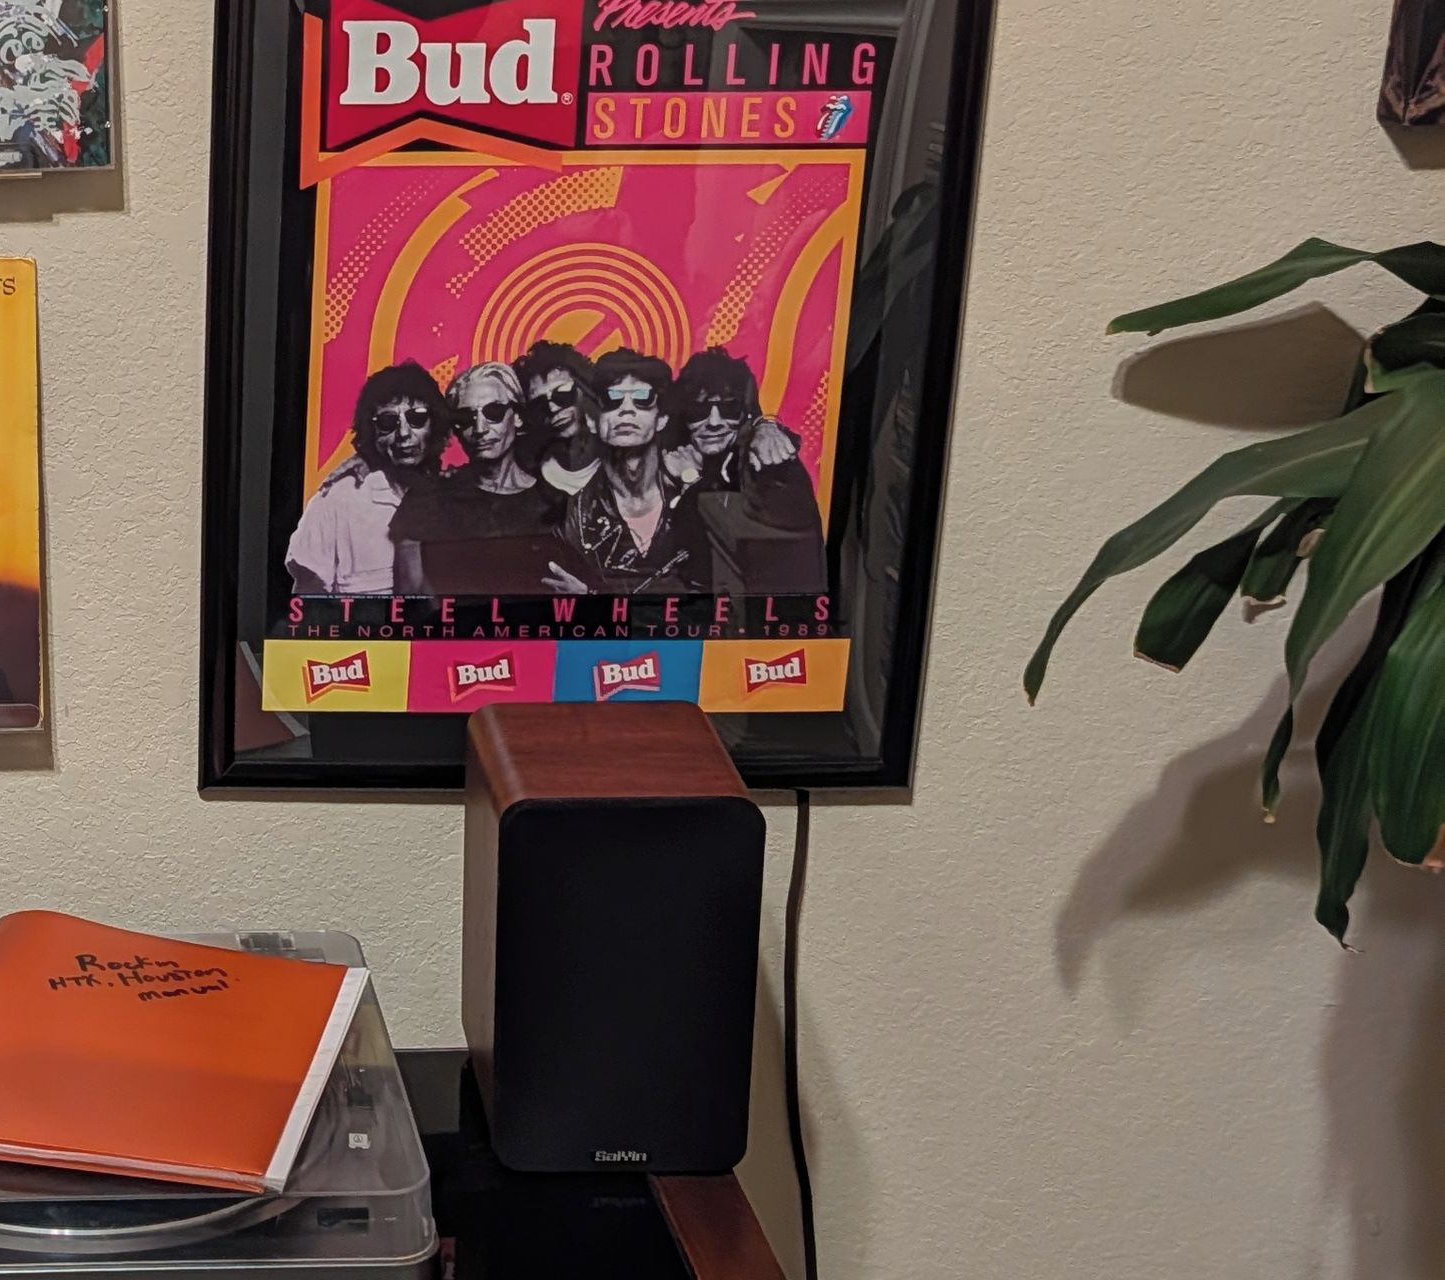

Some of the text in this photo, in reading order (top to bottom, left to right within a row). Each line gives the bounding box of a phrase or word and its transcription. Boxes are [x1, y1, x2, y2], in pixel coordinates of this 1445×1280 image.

[339, 18, 559, 106] Bud
[589, 42, 876, 87] ROLLING
[593, 95, 798, 141] STONES
[289, 595, 830, 623] STEEL WHEELS
[289, 623, 829, 638] THE NORTH AMERICAN TOUR 1989
[311, 659, 365, 685] Bud
[456, 658, 511, 685] Bud
[602, 657, 656, 685] Bud
[747, 657, 802, 684] Bud
[138, 978, 230, 1002] manual
